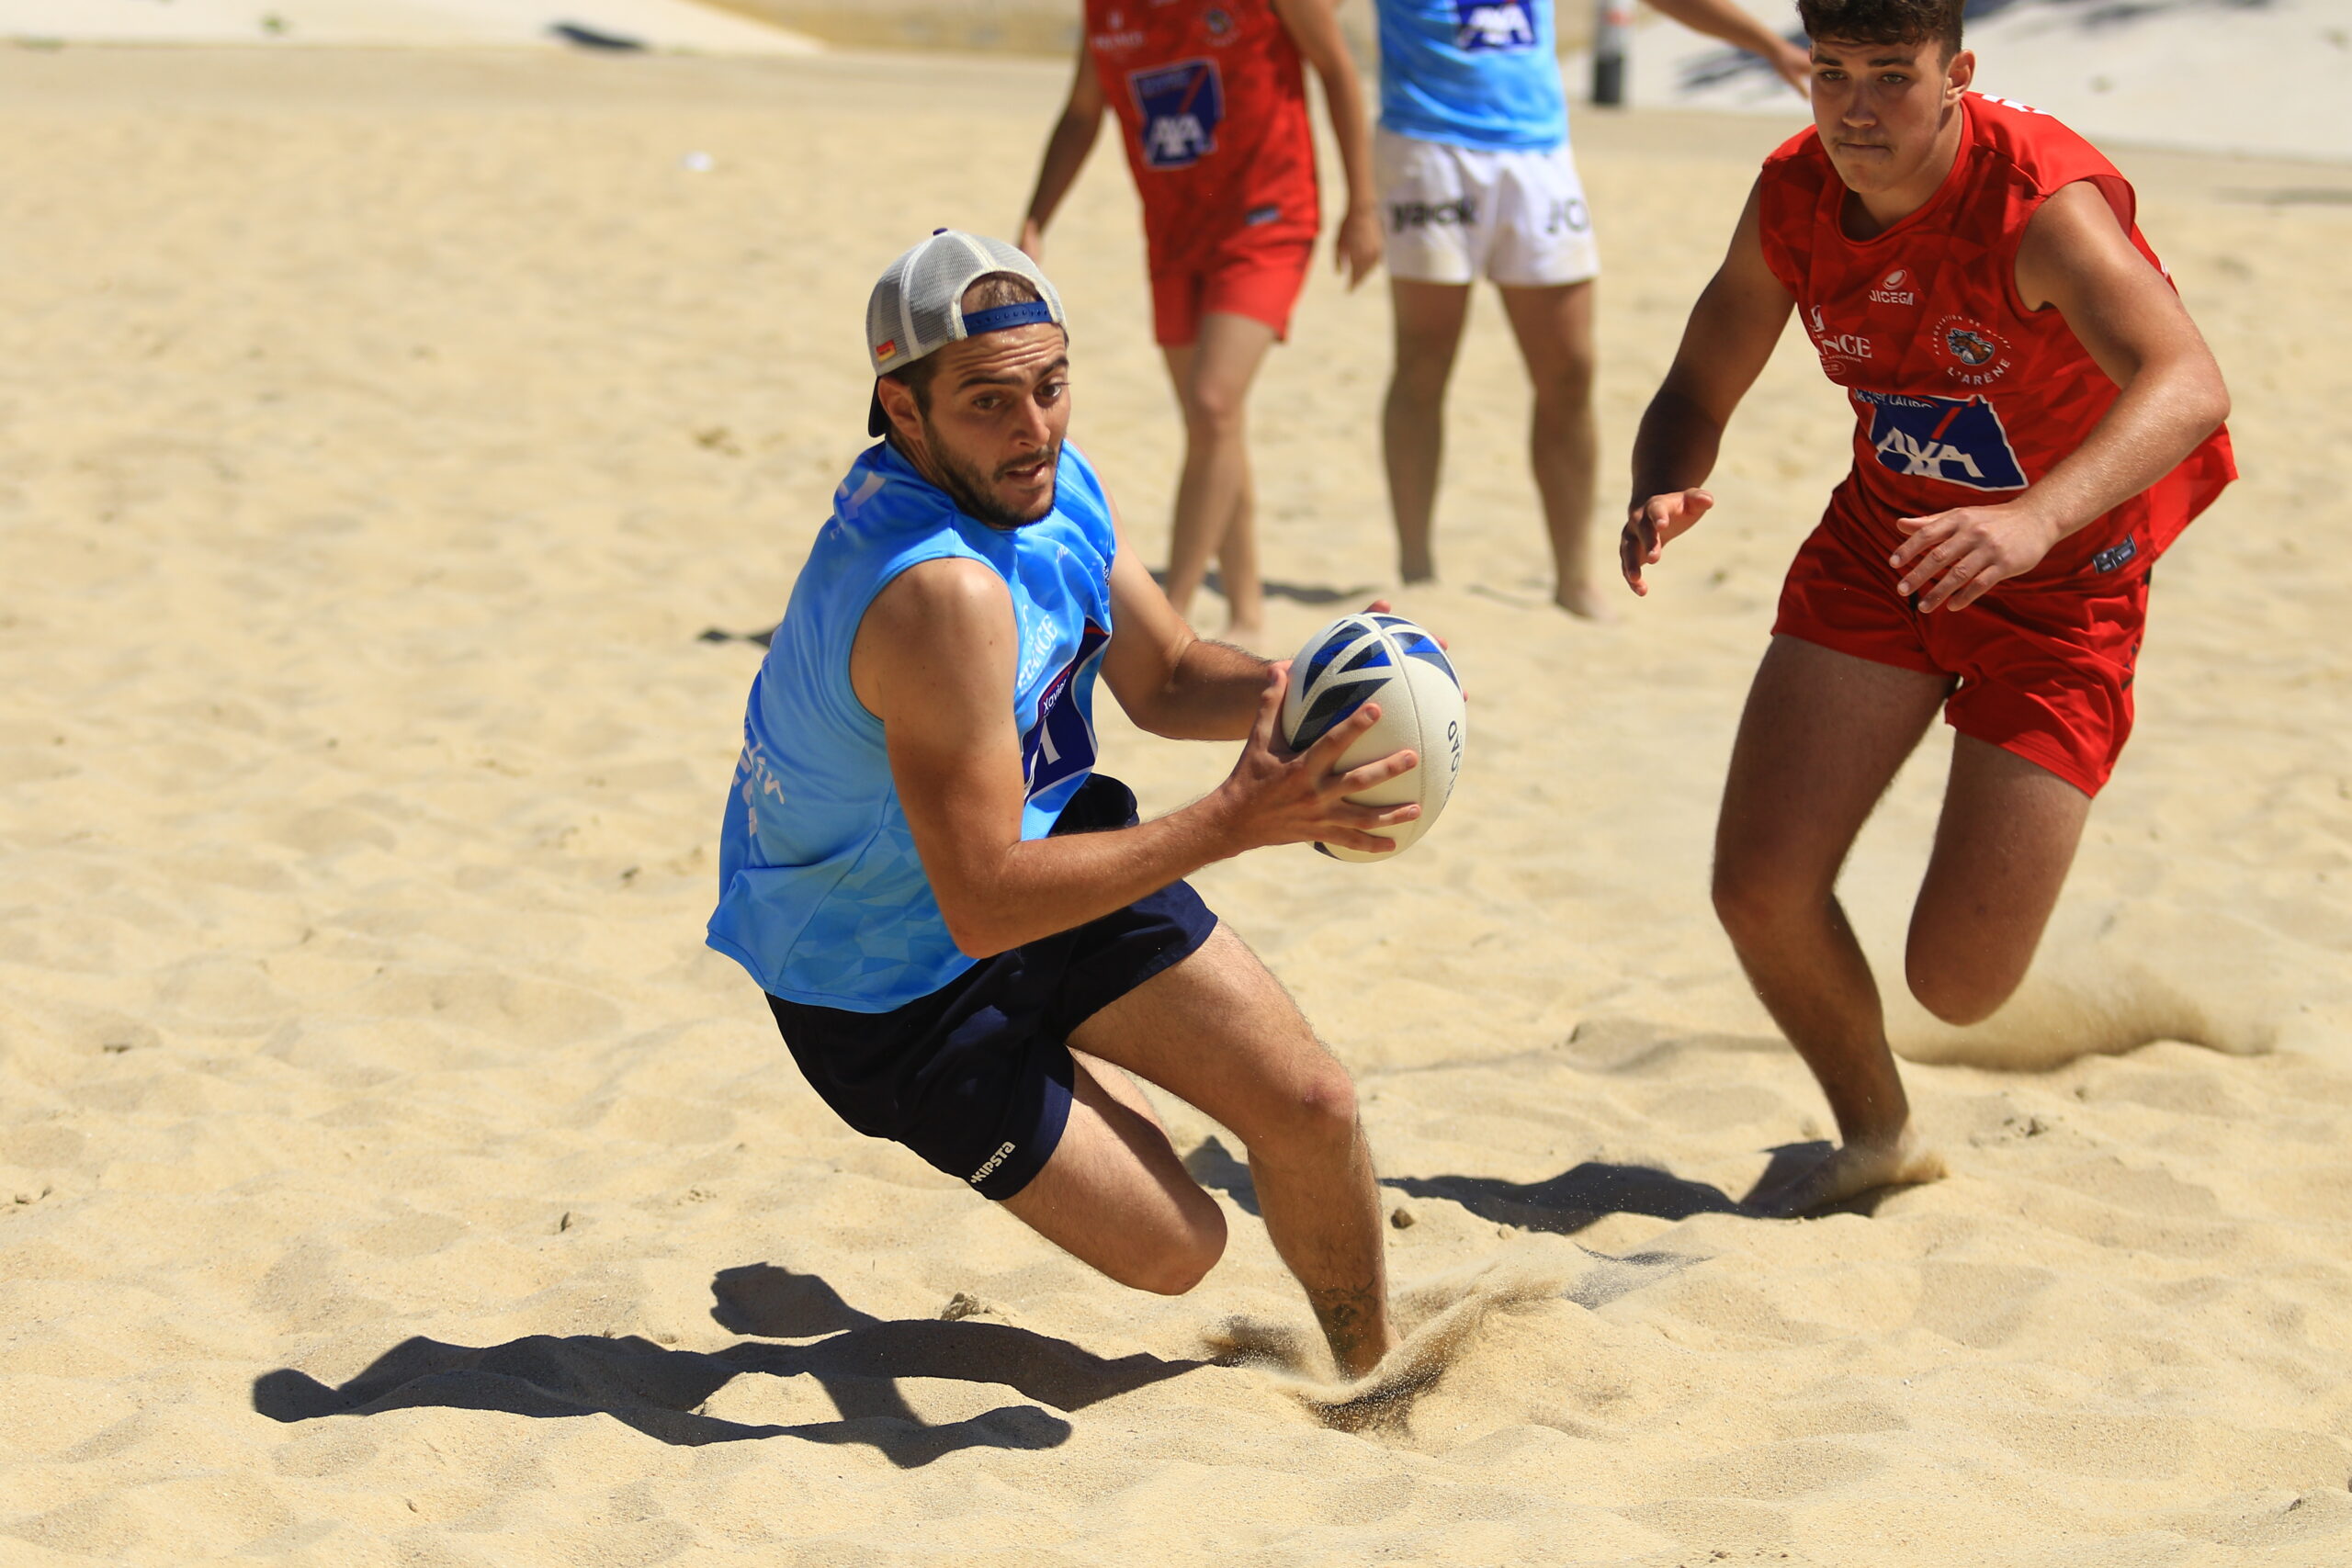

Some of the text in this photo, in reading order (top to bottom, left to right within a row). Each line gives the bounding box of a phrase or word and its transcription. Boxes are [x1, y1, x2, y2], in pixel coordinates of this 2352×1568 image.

[1458, 4, 1534, 48] AXA
[1148, 113, 1211, 159] AXA
[1869, 289, 1914, 306] JICEGA
[1876, 426, 1985, 479] AXA
[970, 1141, 1016, 1183] KIPSTA
